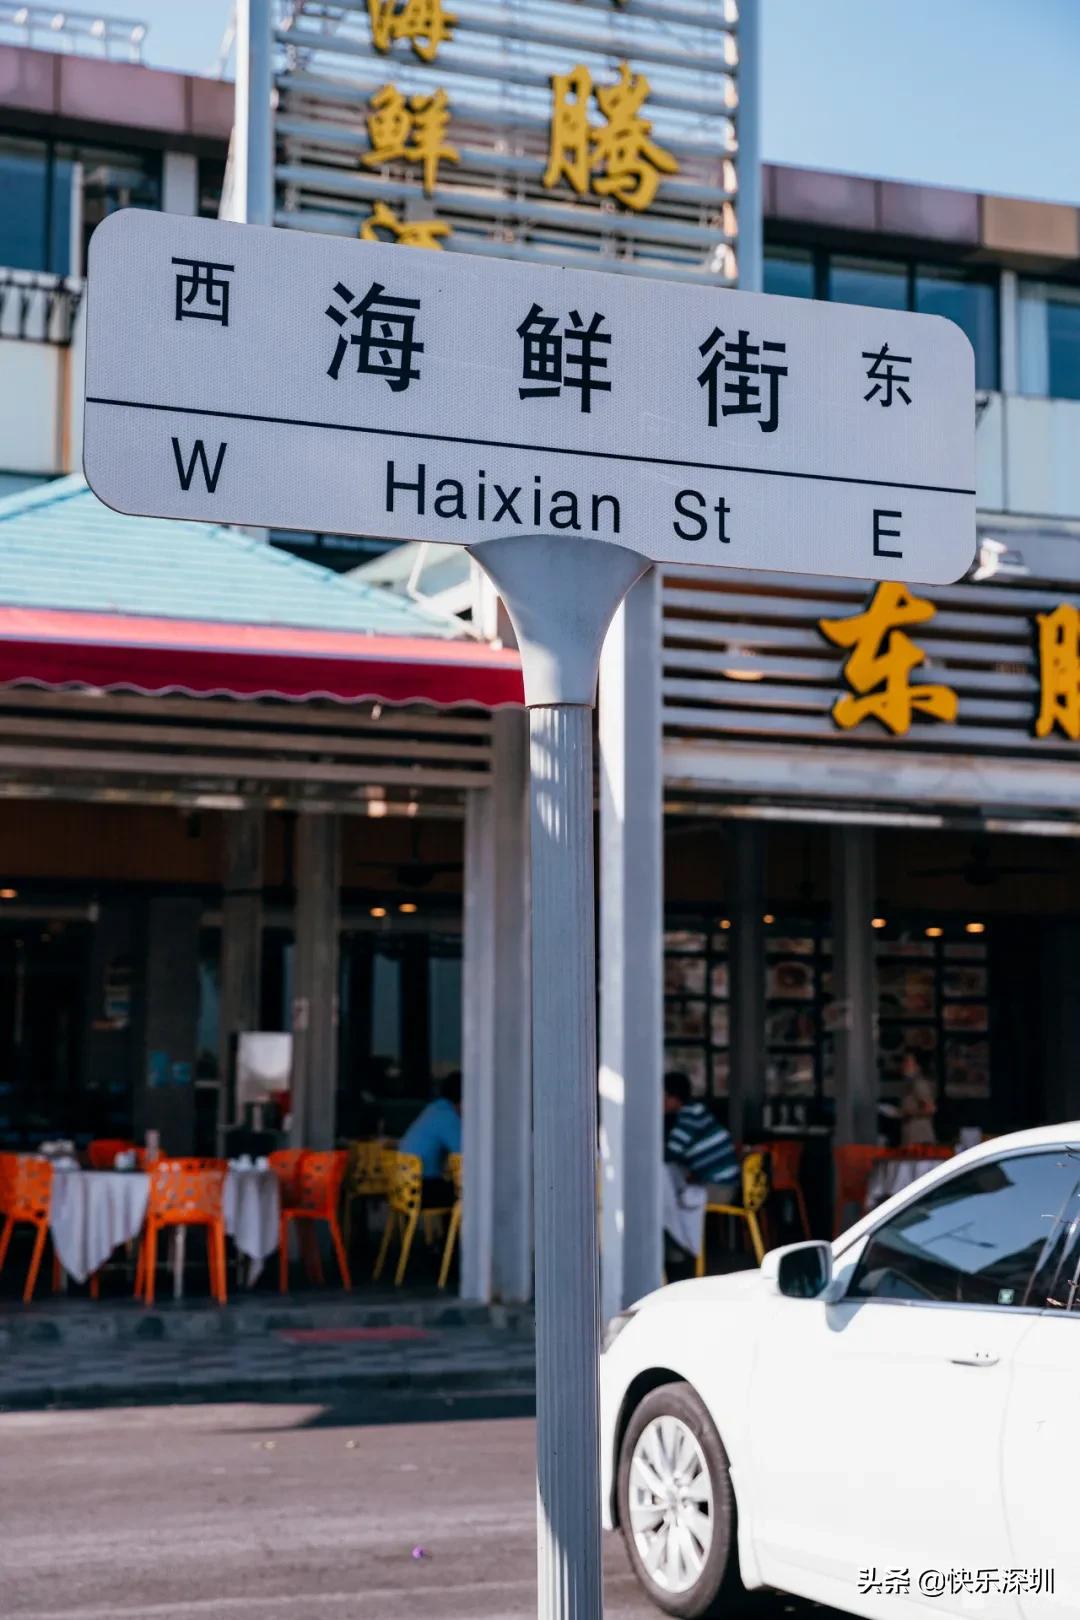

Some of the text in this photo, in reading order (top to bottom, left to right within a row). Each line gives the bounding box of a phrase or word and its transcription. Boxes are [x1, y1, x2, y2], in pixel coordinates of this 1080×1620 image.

[172, 257, 912, 433] 西 海鲜街 东
[171, 437, 903, 558] W Haixian St E
